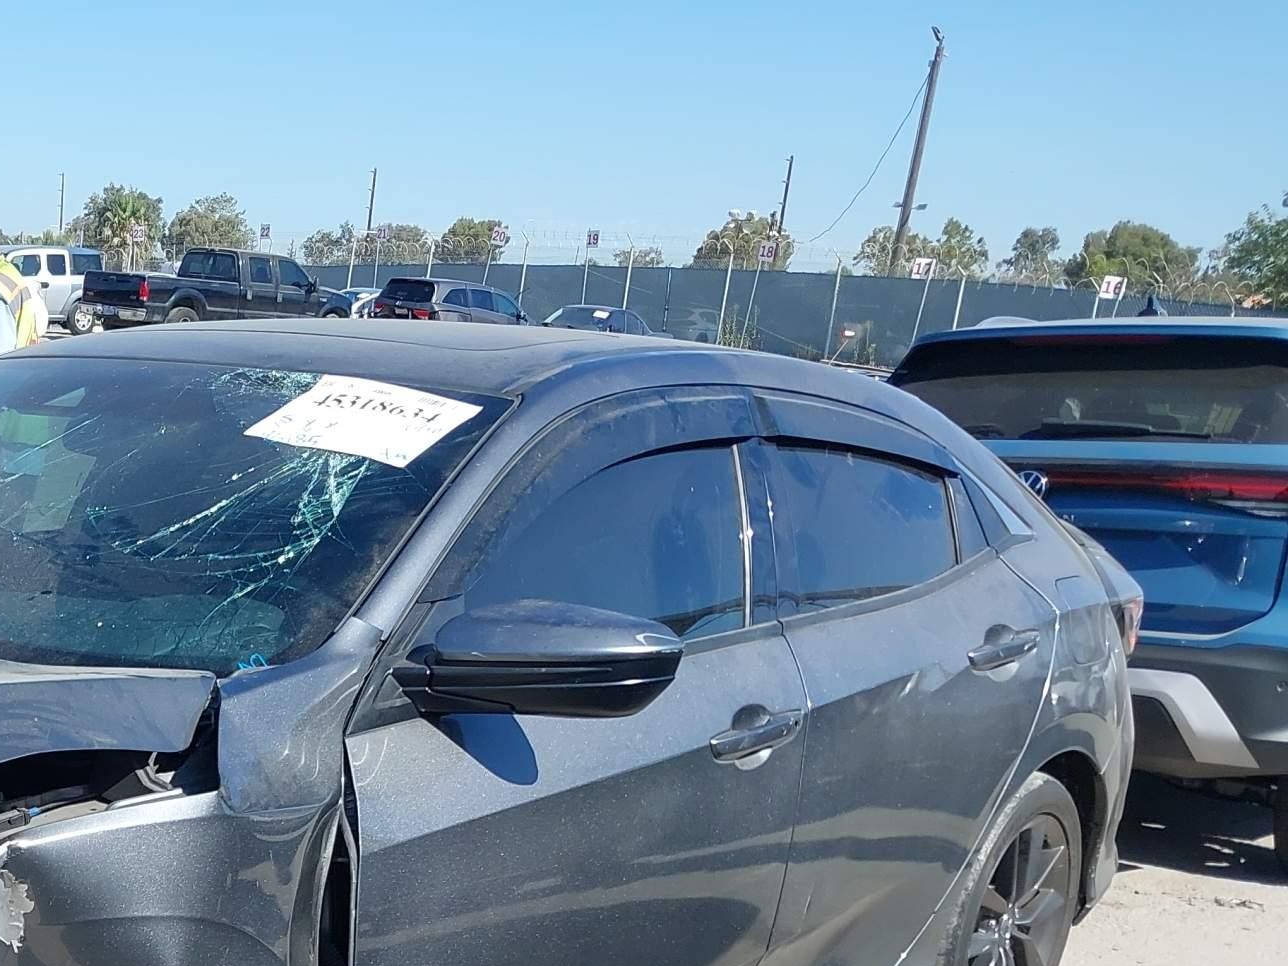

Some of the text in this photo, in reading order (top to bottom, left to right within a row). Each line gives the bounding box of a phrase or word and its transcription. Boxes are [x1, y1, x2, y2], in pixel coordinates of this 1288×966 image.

[133, 230, 144, 239] 23
[377, 228, 386, 239] 21
[493, 230, 506, 242] 20
[587, 233, 599, 246] 19
[759, 244, 774, 258] 18
[915, 261, 933, 276] 17
[1104, 280, 1123, 295] 16
[312, 393, 442, 424] 45318634
